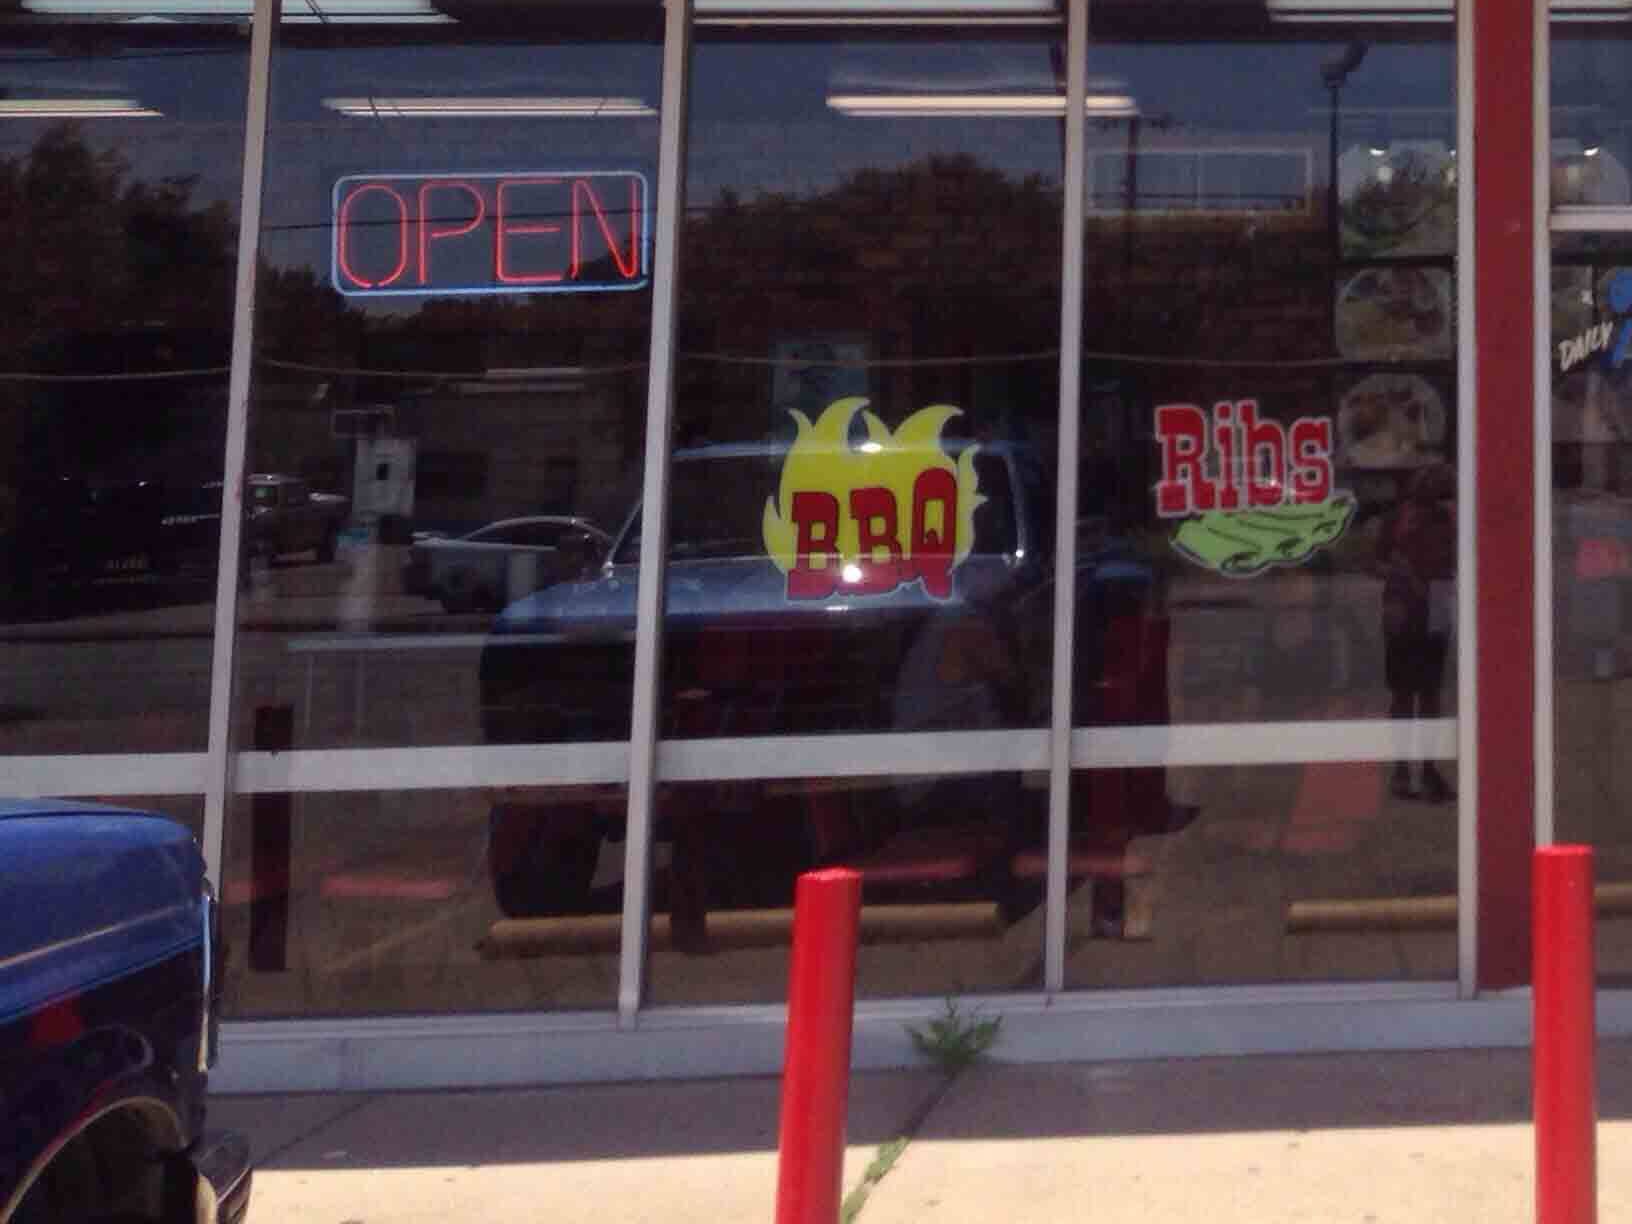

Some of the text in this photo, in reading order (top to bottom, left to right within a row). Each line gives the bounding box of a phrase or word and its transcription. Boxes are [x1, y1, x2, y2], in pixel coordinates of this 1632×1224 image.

[338, 176, 641, 289] OPEN
[1155, 400, 1332, 517] Ribs
[786, 466, 958, 600] BBQ
